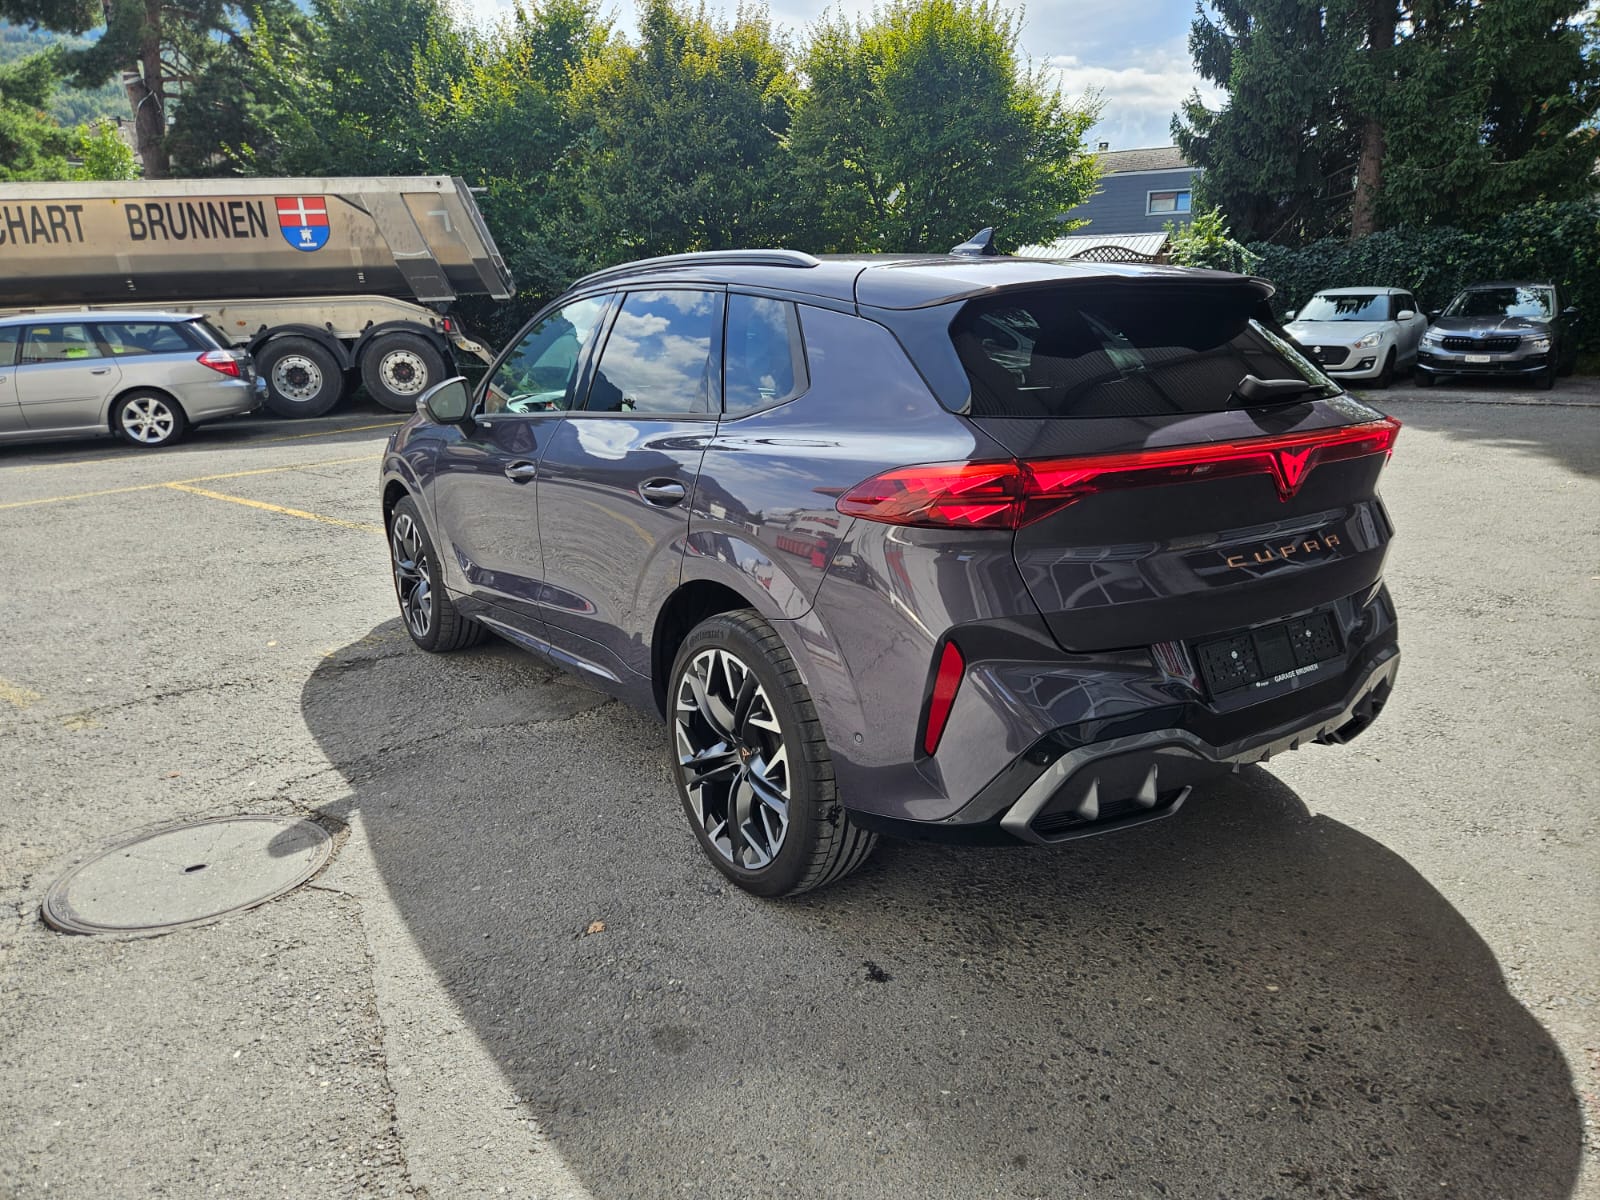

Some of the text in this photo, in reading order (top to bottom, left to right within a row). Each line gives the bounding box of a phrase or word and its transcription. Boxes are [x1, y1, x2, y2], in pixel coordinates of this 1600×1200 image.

[0, 200, 269, 245] HART BRUNNEN
[1227, 534, 1341, 568] CUPRA
[1274, 670, 1296, 683] GARAGE
